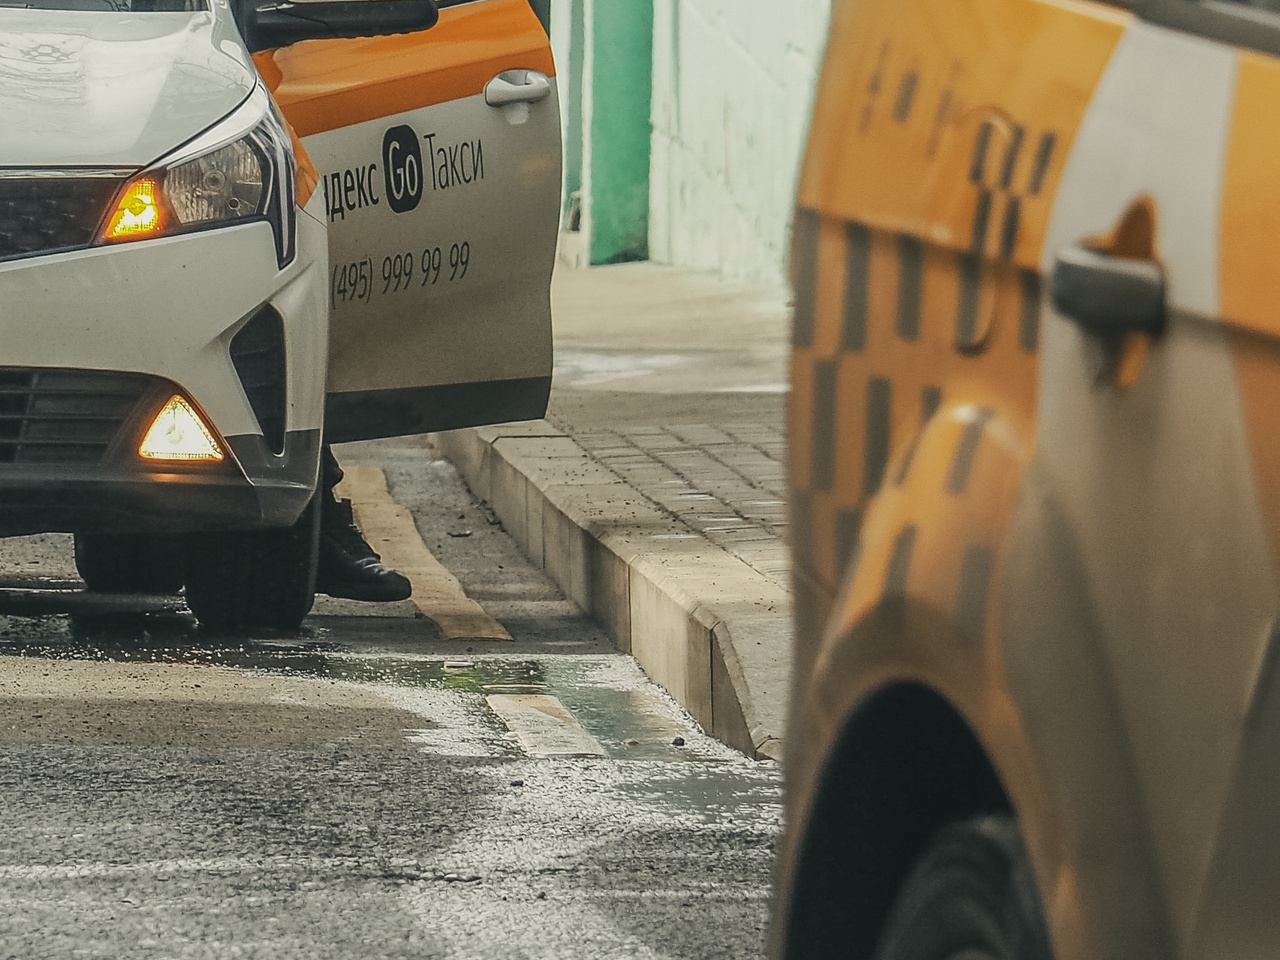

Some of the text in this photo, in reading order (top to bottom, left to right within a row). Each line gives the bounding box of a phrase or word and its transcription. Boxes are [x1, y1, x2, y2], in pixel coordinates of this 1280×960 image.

[387, 140, 420, 201] Go
[423, 132, 485, 191] Такси
[331, 241, 470, 310] (495) 999 99 99
